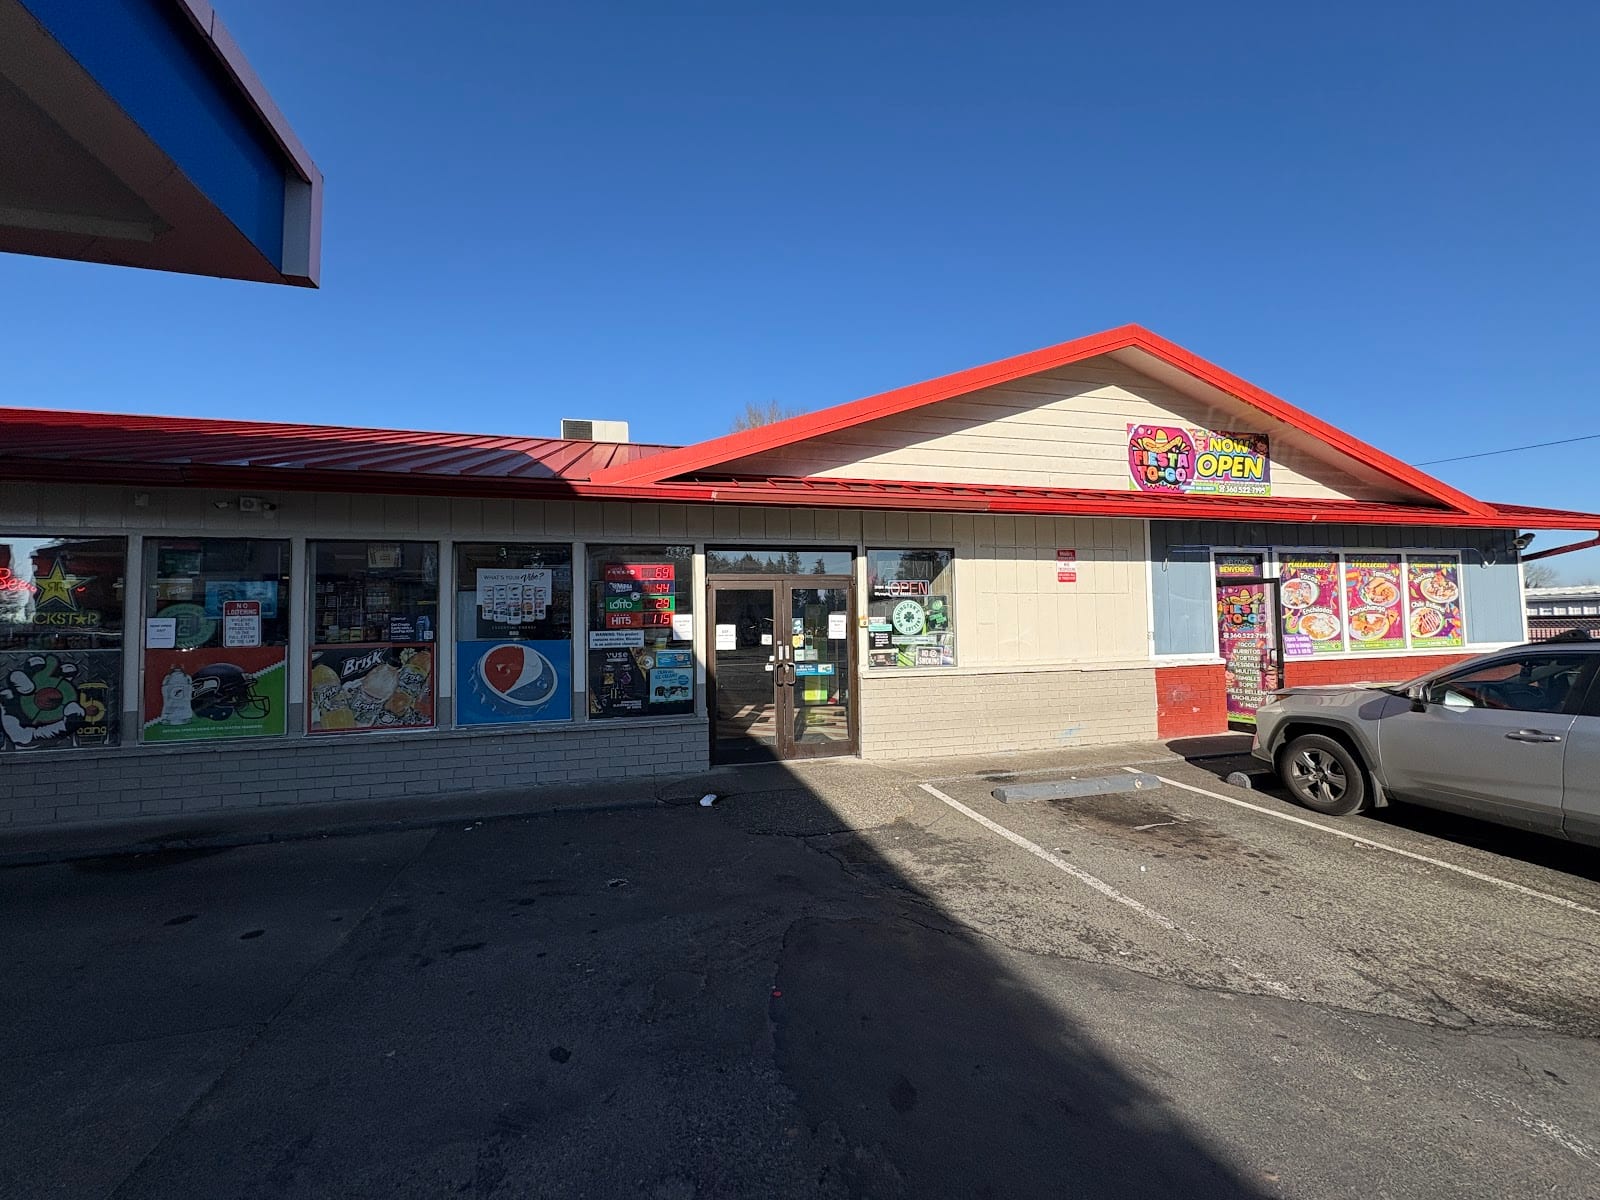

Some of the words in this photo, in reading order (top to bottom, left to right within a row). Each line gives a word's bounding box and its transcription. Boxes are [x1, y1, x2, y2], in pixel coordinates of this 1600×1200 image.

[1209, 437, 1249, 454] NOW
[1134, 451, 1189, 468] FIESTA
[1196, 453, 1264, 479] OPEN
[1137, 466, 1187, 483] TO-GO
[655, 567, 669, 579] 69
[1300, 572, 1319, 584] Tacos
[1414, 571, 1434, 584] Nachos
[655, 583, 670, 593] 44
[889, 581, 929, 596] OPEN
[609, 598, 633, 609] LOTTO
[655, 598, 669, 609] 29
[1302, 606, 1333, 615] Enchiladas
[342, 650, 385, 678] Brisk
